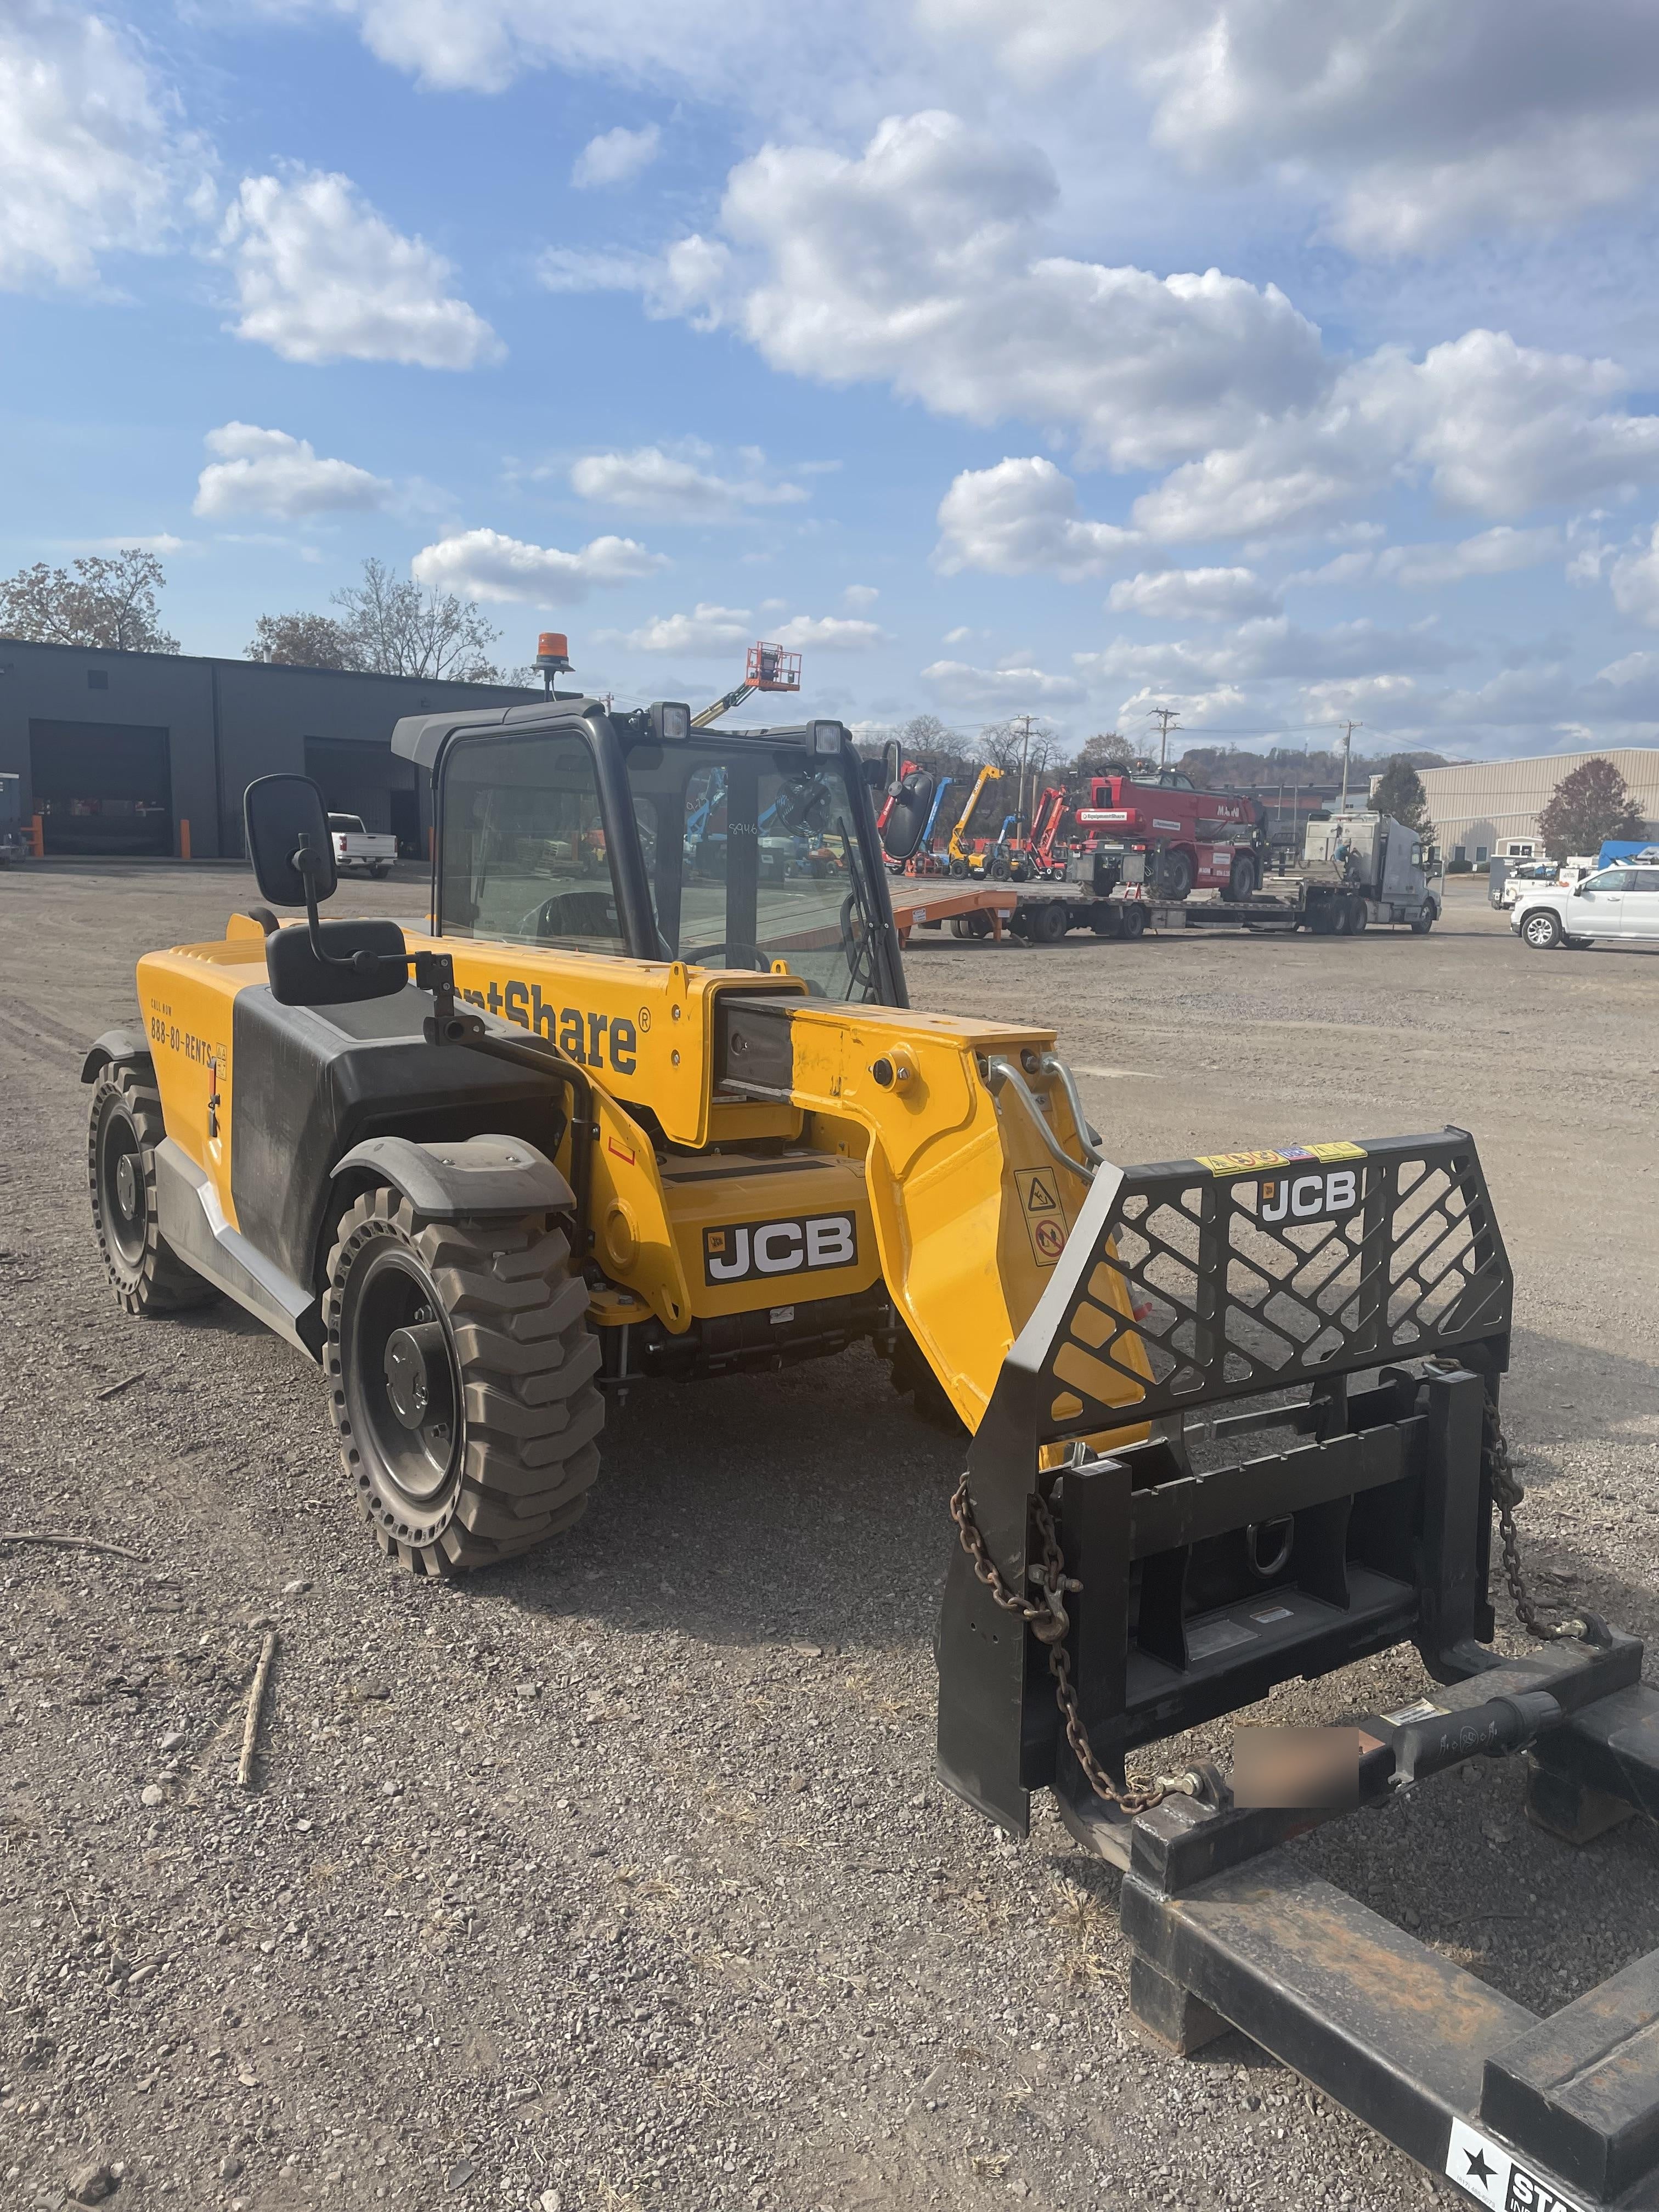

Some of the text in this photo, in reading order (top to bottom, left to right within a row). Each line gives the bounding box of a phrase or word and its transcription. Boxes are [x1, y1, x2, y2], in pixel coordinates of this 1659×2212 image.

[729, 823, 758, 835] 8946
[151, 997, 172, 1017] CALL NOW
[454, 980, 651, 1075] ntShare®
[151, 1016, 211, 1068] 888-80-RENTS
[1262, 1171, 1356, 1222] JCB
[709, 1217, 854, 1279] JCB
[1457, 2175, 1470, 2190] (817)
